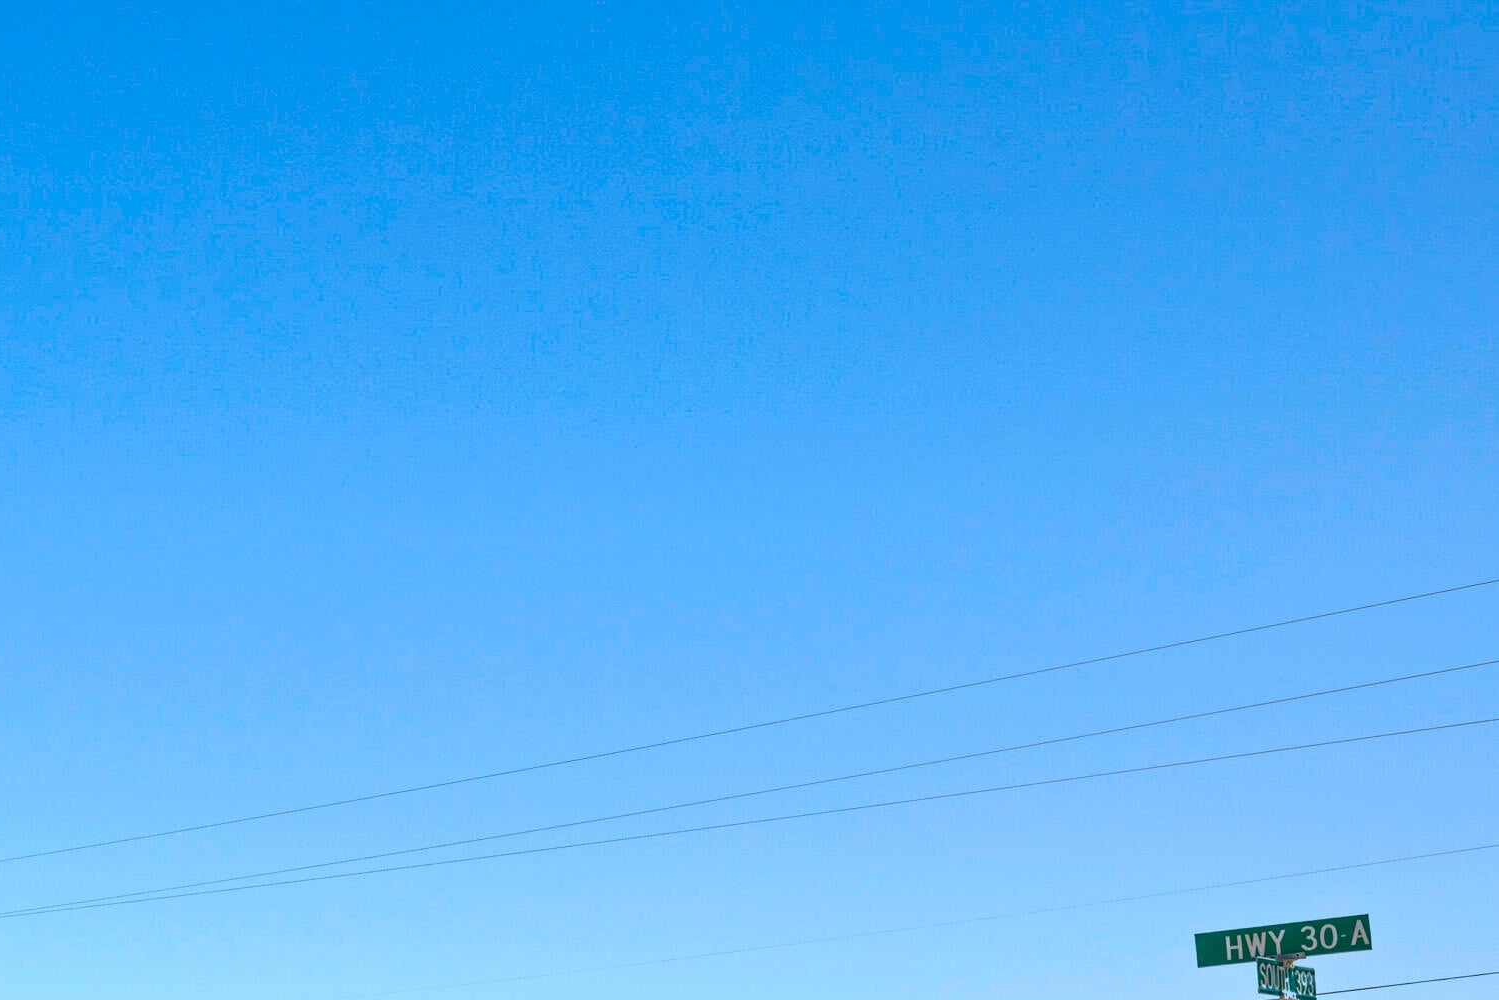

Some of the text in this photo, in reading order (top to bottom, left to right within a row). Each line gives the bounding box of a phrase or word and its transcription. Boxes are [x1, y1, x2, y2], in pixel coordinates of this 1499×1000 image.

[1225, 919, 1370, 961] HWY 30-A
[1259, 963, 1315, 996] SOUTH 393
